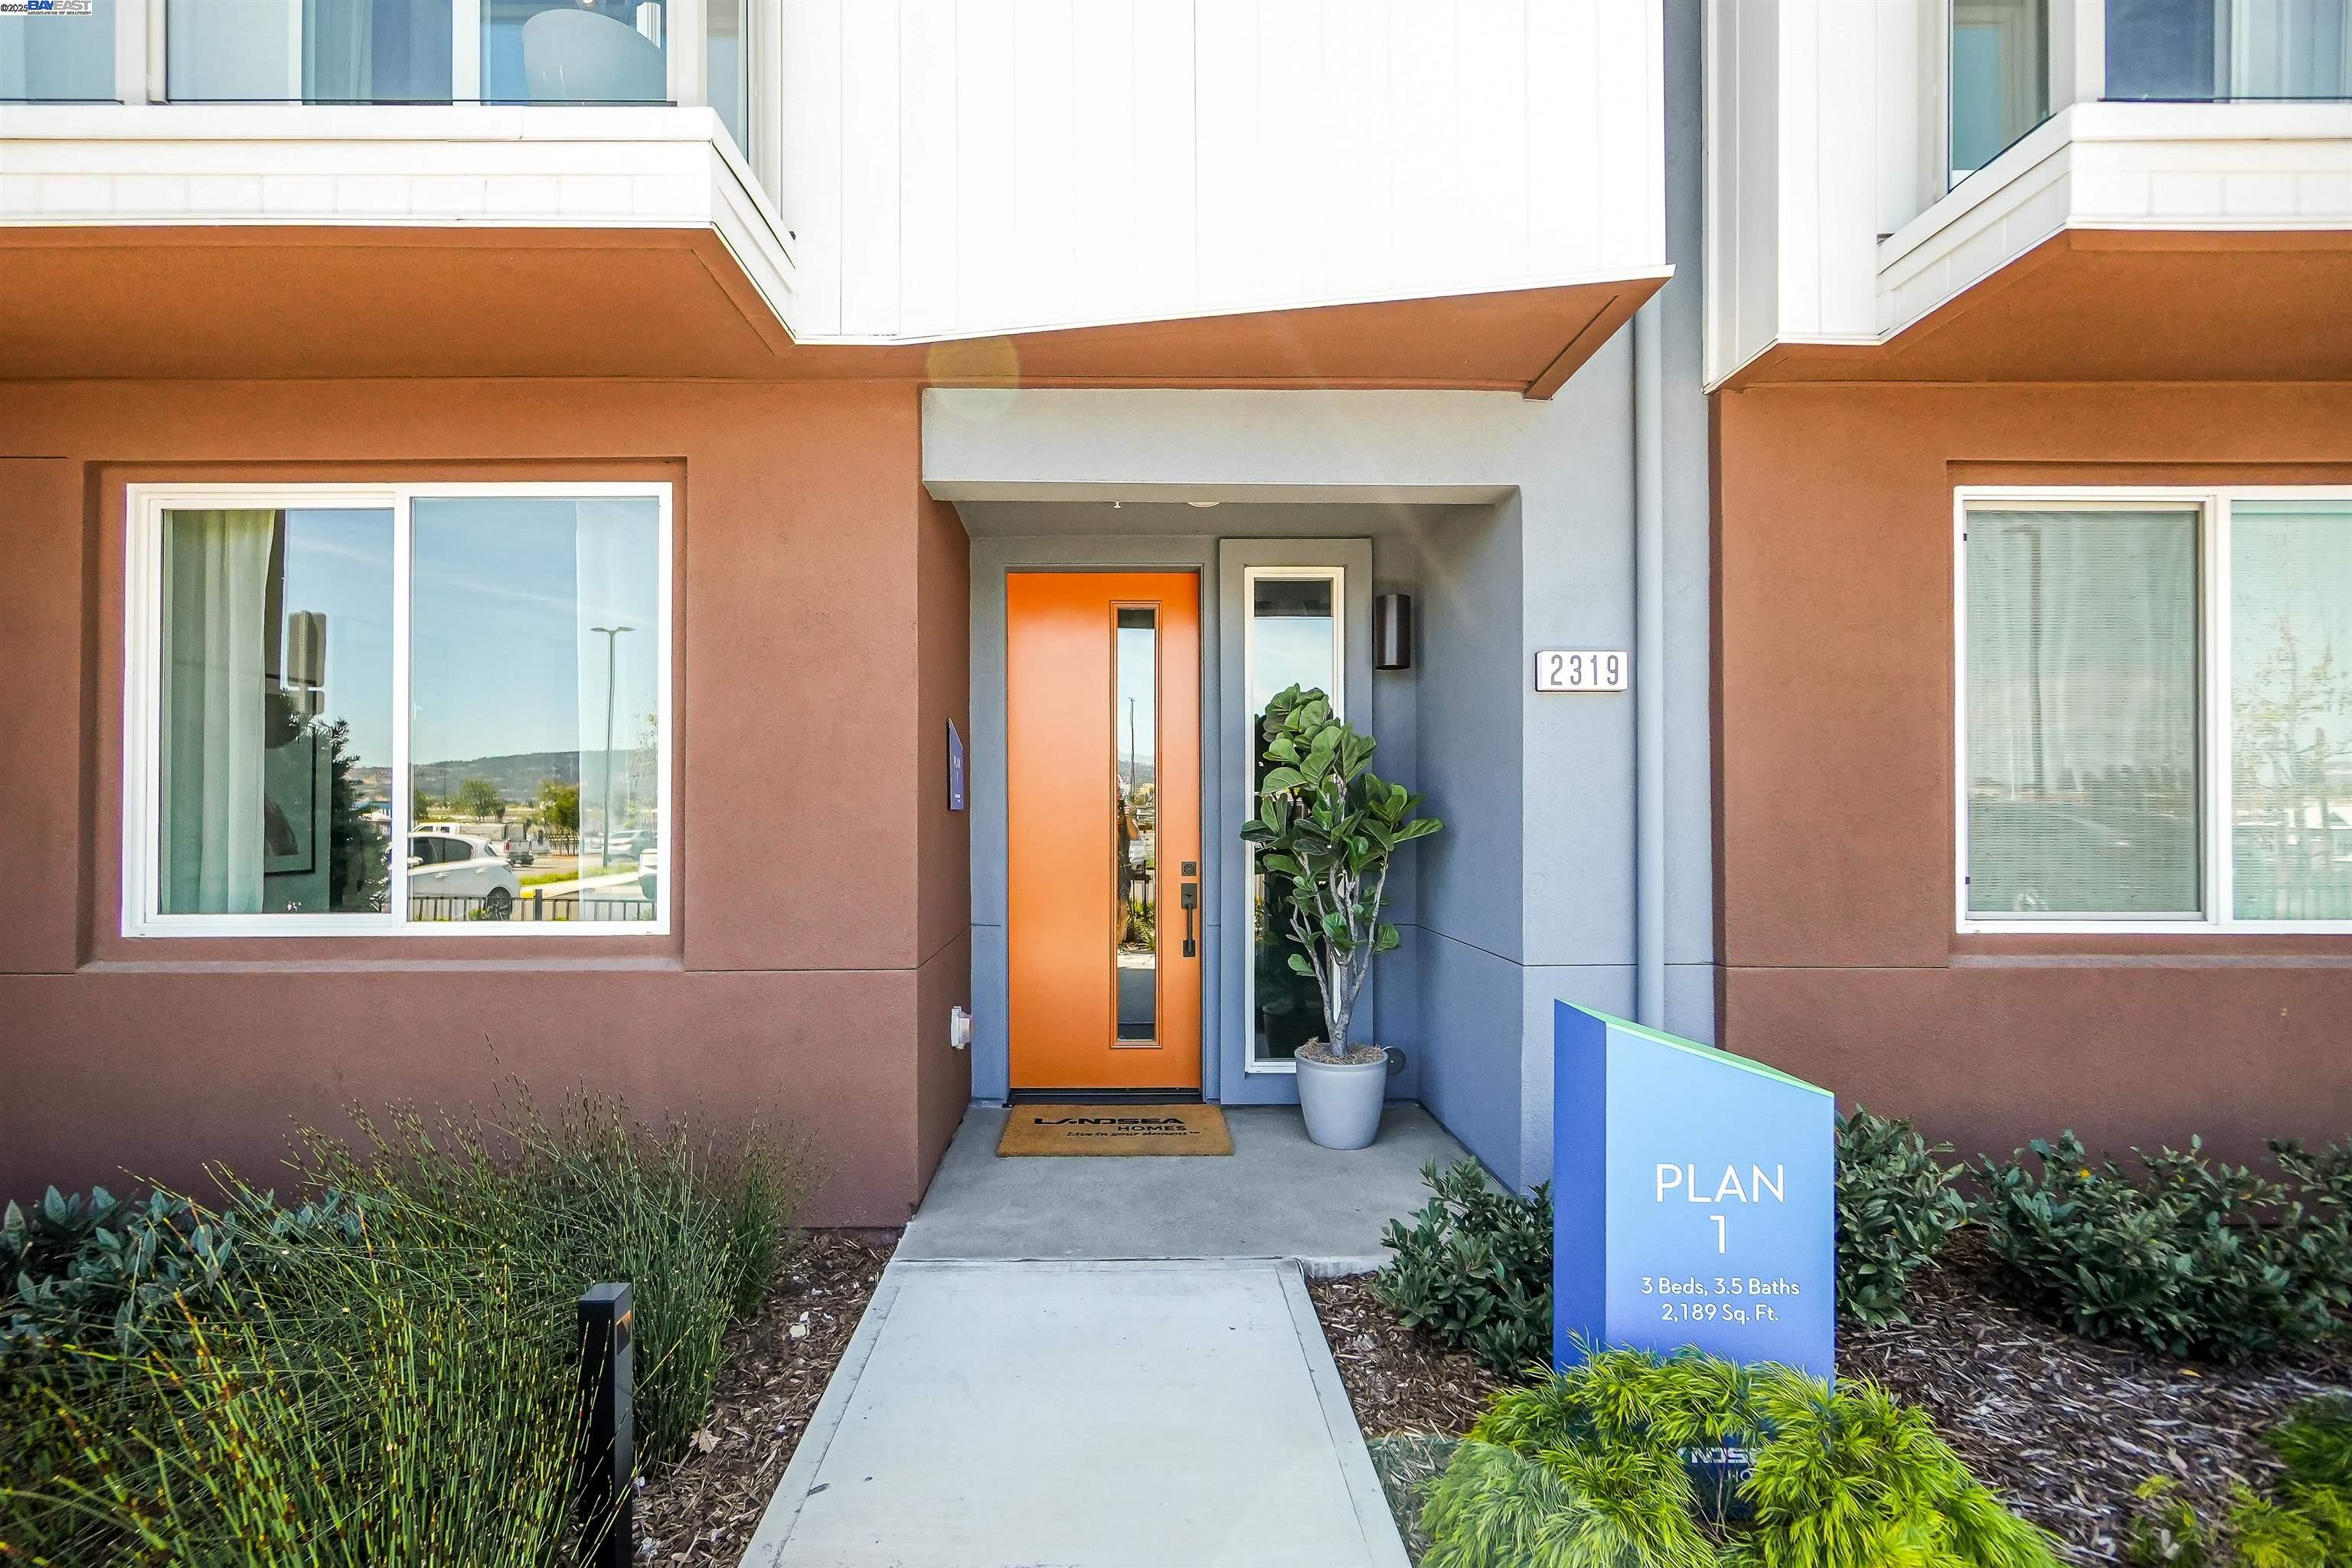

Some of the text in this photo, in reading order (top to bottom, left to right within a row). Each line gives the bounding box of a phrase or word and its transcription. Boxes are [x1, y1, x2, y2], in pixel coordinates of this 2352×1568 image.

[1550, 654, 1619, 686] 2319
[1655, 1163, 1785, 1203] PLAN
[1710, 1214, 1726, 1254] 1
[1641, 1276, 1800, 1296] 3 Beds, 3.5 Baths
[1661, 1303, 1780, 1325] 2,189 Sq. Ft.
